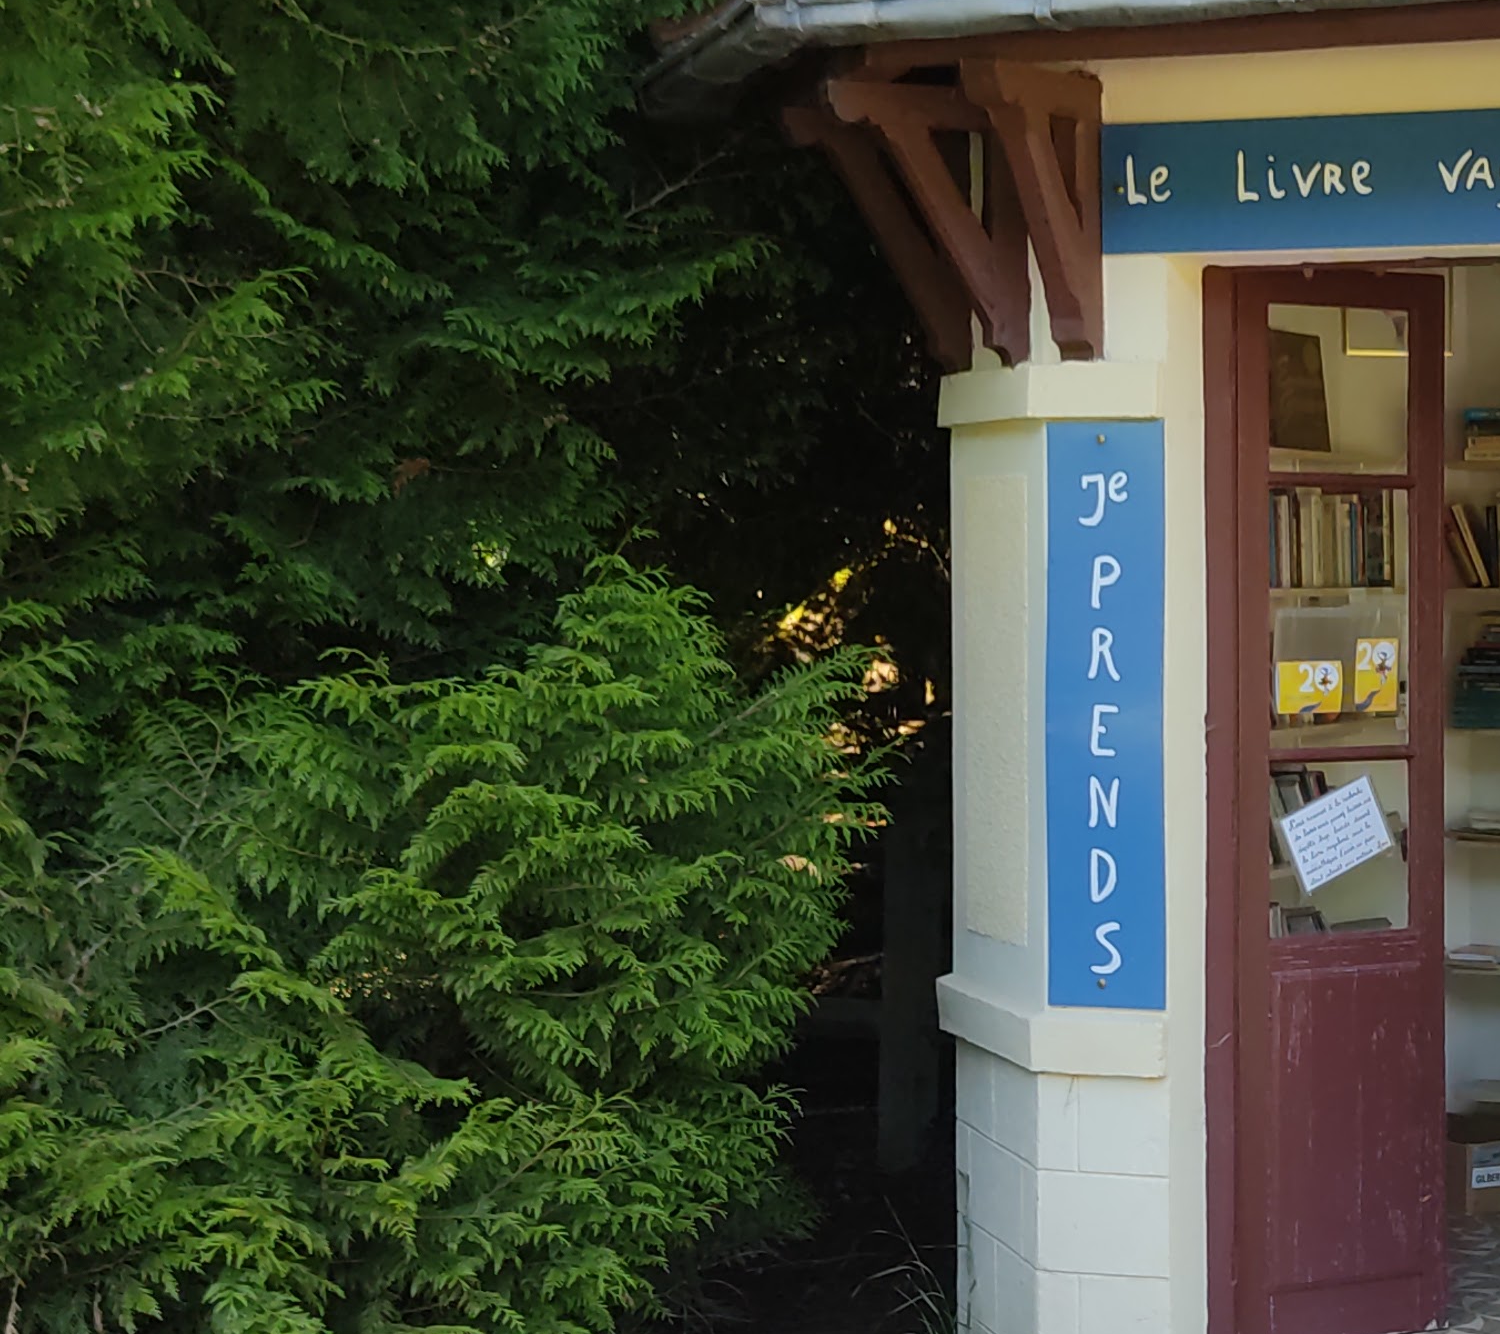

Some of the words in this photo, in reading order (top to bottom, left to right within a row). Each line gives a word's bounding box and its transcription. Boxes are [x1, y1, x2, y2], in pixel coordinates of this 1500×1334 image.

[1126, 155, 1171, 205] Le
[1078, 471, 1128, 526] Je
[1087, 554, 1122, 975] PRENDS
